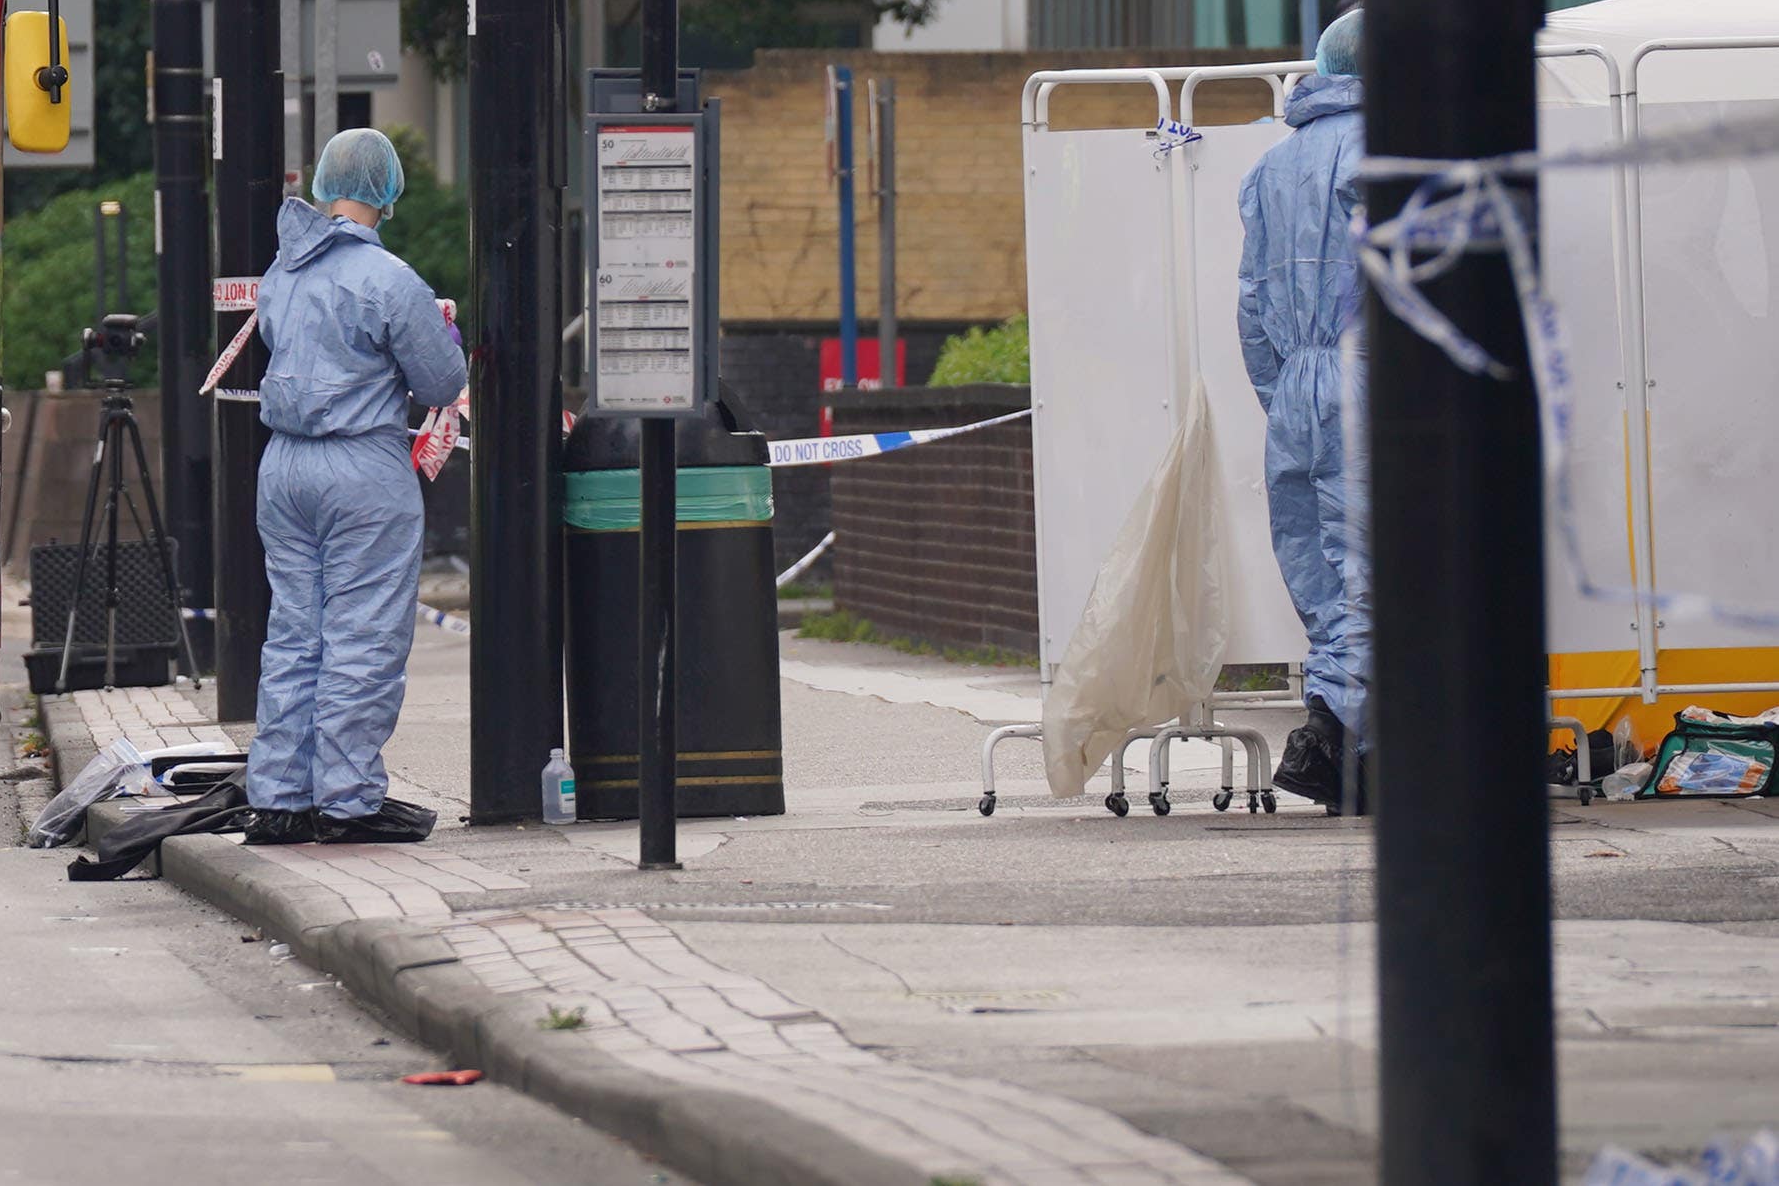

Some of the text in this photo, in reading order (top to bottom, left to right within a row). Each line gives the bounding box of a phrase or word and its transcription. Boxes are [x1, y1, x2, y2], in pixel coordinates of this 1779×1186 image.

[601, 140, 614, 150] 50
[599, 274, 612, 284] 60
[775, 439, 863, 463] DO NOT CROSS
